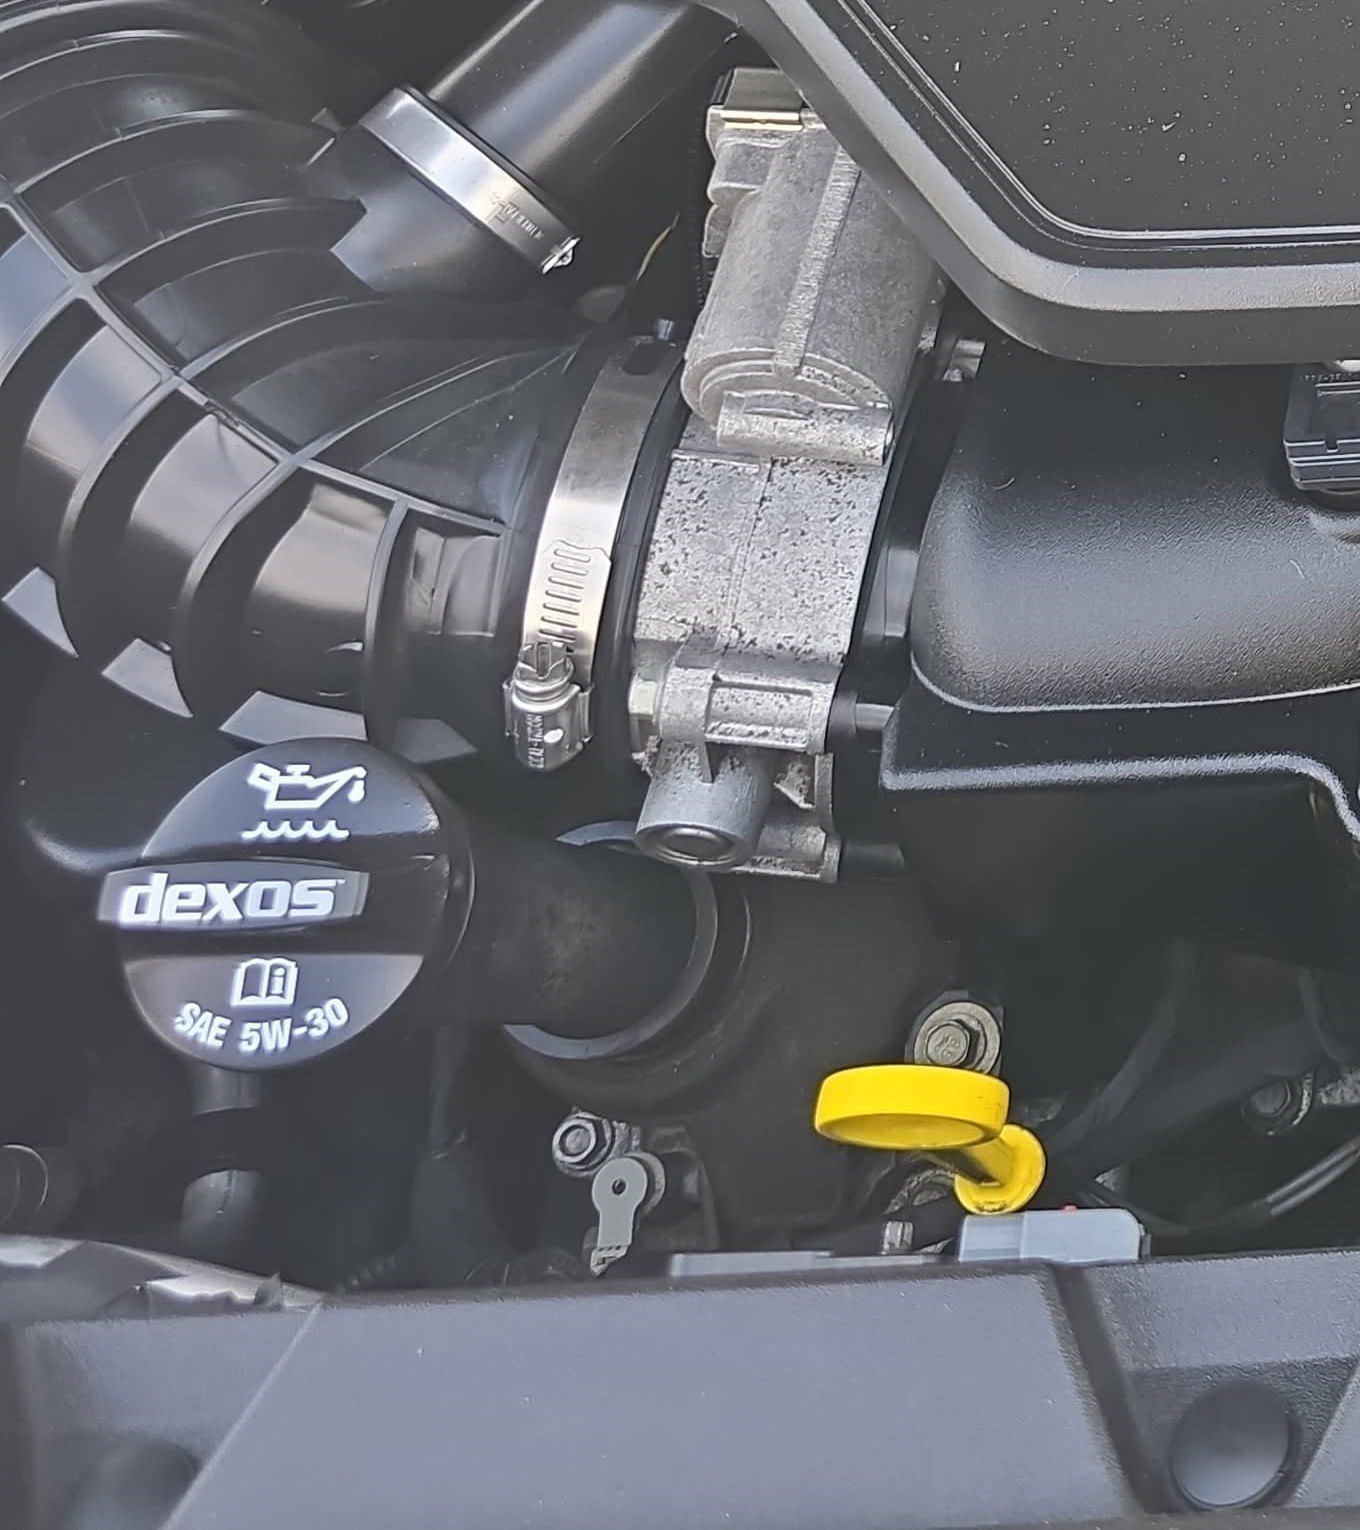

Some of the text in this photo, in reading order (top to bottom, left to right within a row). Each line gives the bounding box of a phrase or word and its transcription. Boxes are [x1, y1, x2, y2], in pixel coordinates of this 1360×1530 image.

[120, 873, 337, 924] dexos
[175, 997, 350, 1051] SAE 5W-30
